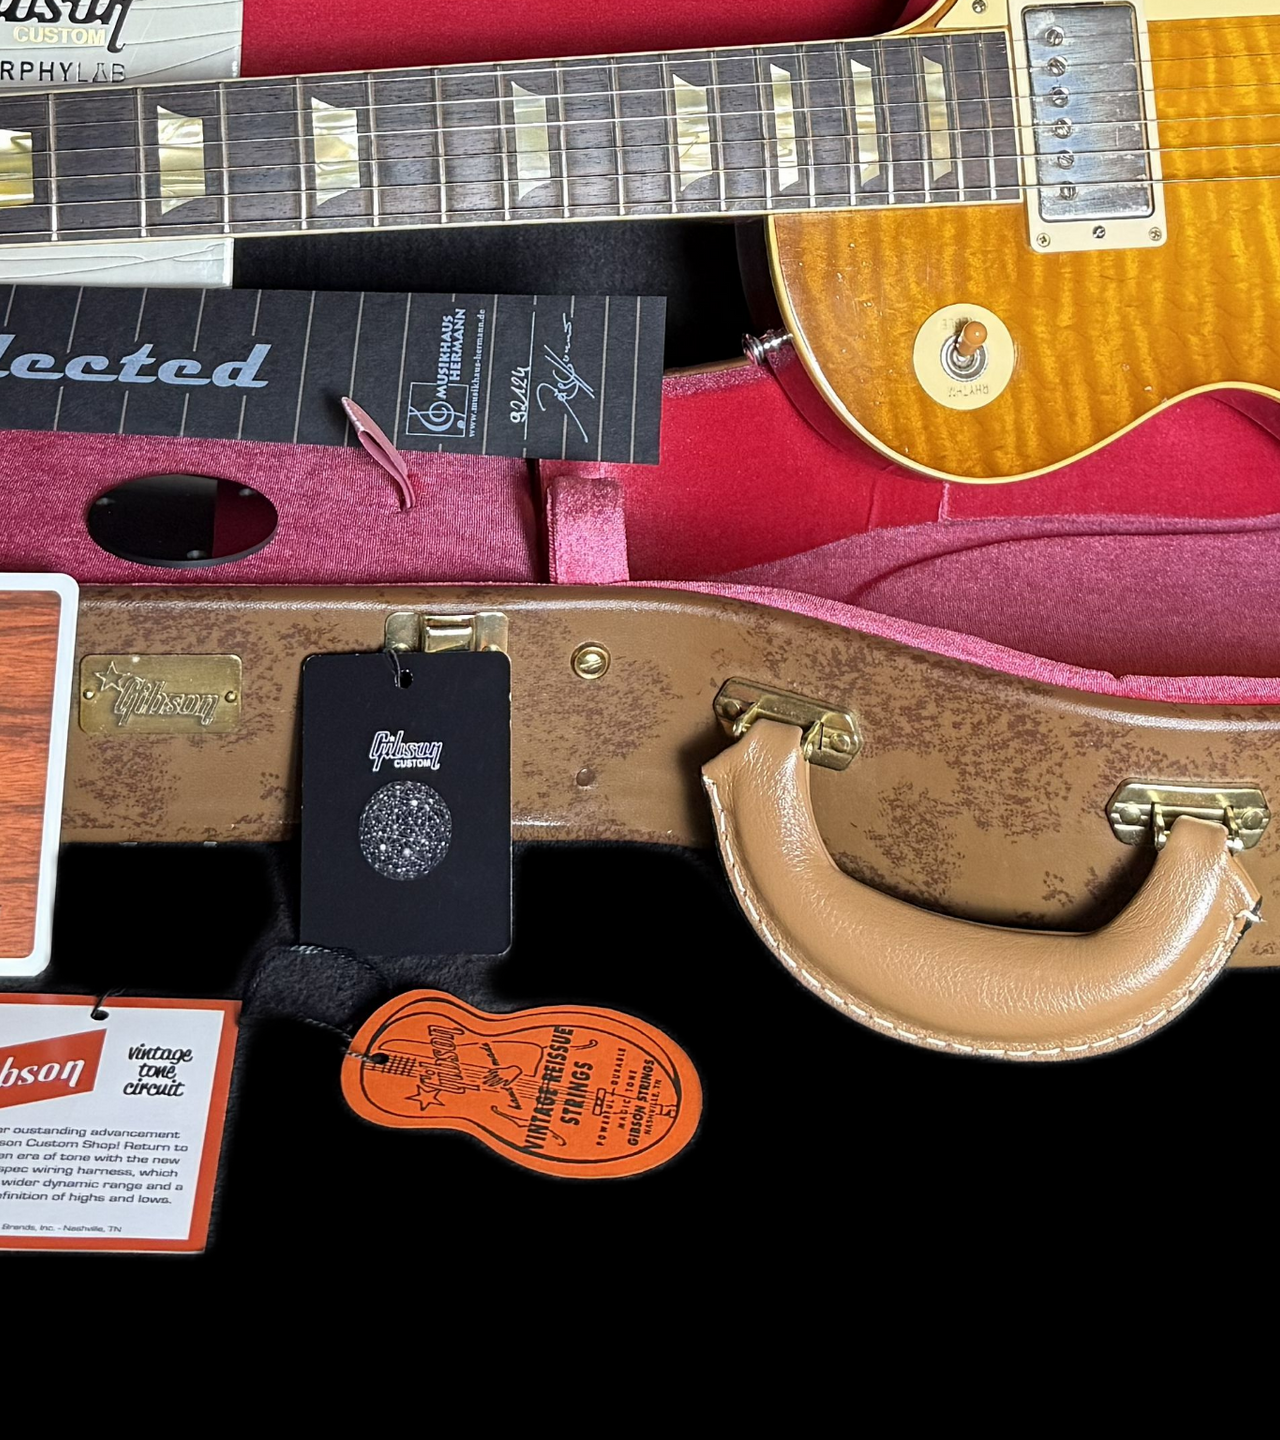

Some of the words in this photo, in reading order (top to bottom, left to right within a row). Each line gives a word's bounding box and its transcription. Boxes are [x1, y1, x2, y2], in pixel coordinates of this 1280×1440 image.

[13, 26, 106, 45] CUSTOM
[450, 308, 466, 381] HERMANN
[436, 315, 454, 400] MUSIKHAUS
[469, 308, 486, 438] www.musikhaus-hermann.de
[114, 673, 220, 726] Gibson
[369, 731, 443, 772] Gibson
[394, 760, 431, 769] CUSTOM
[128, 1043, 193, 1064] vintage
[419, 1025, 480, 1094] Gibson
[138, 1061, 176, 1079] tone
[123, 1078, 185, 1097] circuit
[521, 1083, 559, 1150] VINTAGE
[542, 1026, 575, 1083] REISSUE
[560, 1061, 593, 1126] STRINGS
[596, 1100, 615, 1146] POWERFUL
[610, 1048, 626, 1086] DURABLE
[617, 1099, 631, 1129] MAGIC
[625, 1070, 637, 1092] TONE
[627, 1105, 647, 1146] GIBSON
[637, 1059, 655, 1103] STRINGS
[90, 1128, 181, 1139] advancement
[25, 1138, 78, 1148] Custom
[82, 1140, 120, 1151] Shop!
[124, 1141, 170, 1152] Return
[43, 1152, 57, 1160] of
[60, 1153, 90, 1161] tone
[94, 1154, 123, 1163] with
[126, 1154, 149, 1164] the
[32, 1165, 74, 1176] wiring
[77, 1166, 136, 1177] harness,
[139, 1168, 178, 1177] which
[1, 1178, 40, 1187] wider
[43, 1178, 99, 1189] dynamic
[103, 1182, 143, 1191] range
[146, 1182, 172, 1191] and
[52, 1192, 66, 1201] of
[69, 1193, 105, 1203] highs
[109, 1194, 134, 1203] and
[108, 1225, 122, 1233] TN
